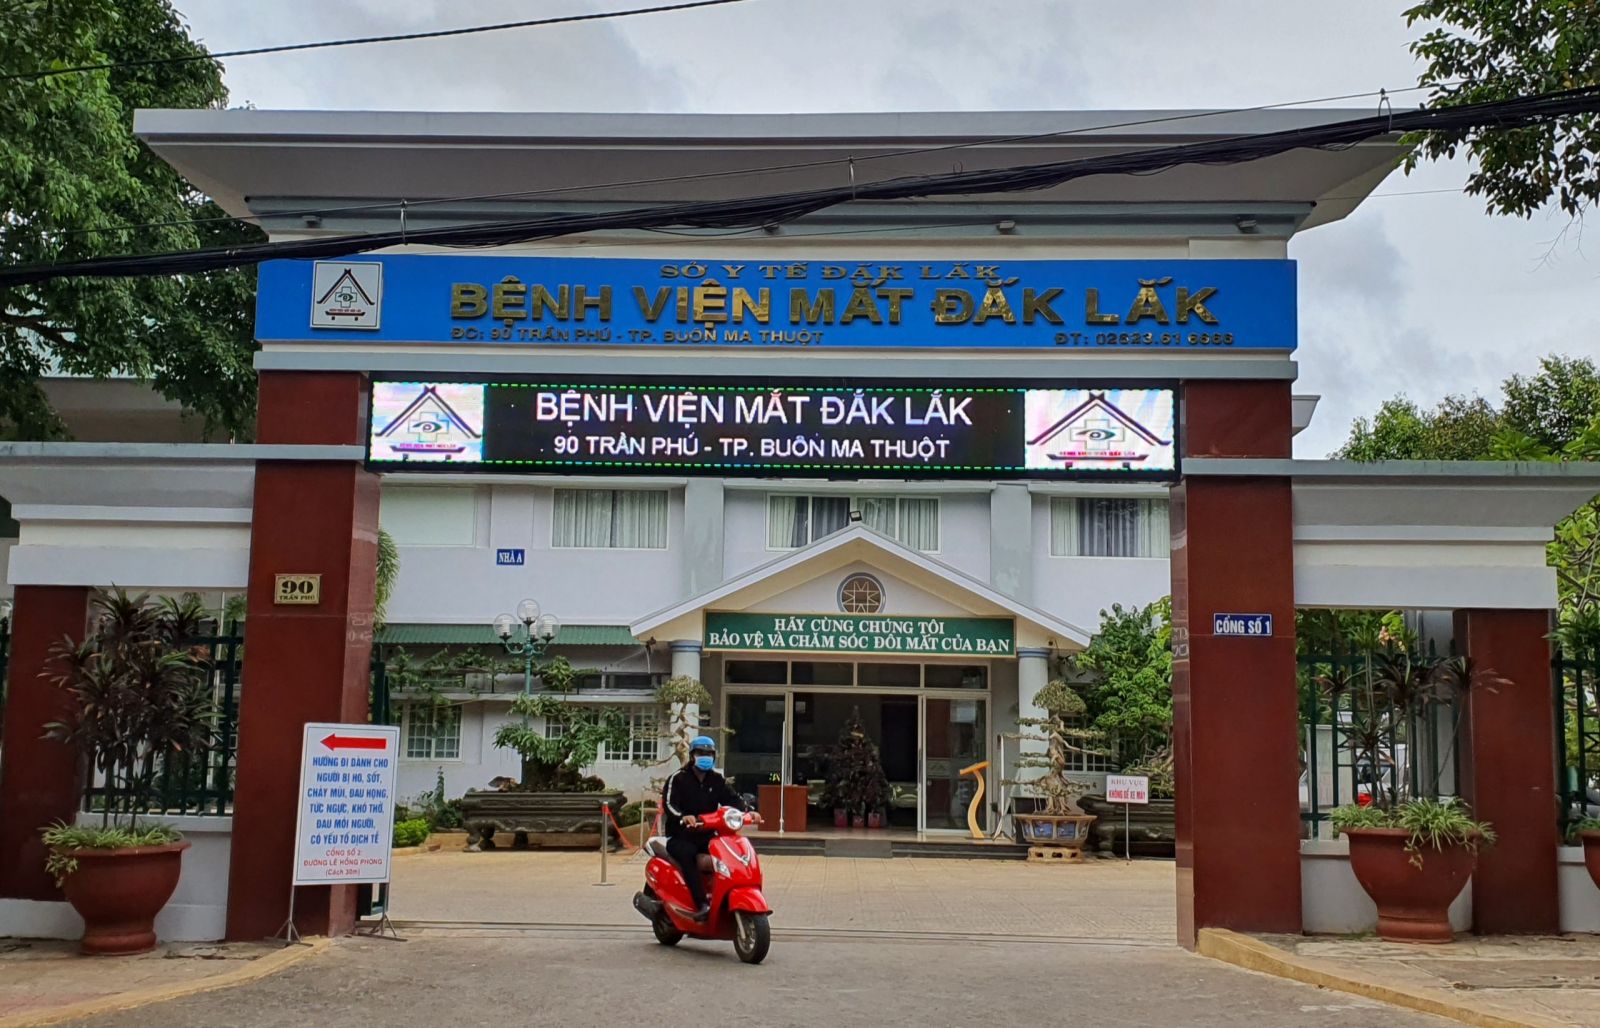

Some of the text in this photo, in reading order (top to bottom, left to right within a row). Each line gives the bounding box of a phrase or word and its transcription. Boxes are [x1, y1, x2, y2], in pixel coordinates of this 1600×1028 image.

[660, 262, 1000, 279] SỞ Y TẾ ĐẮK LẮK
[452, 275, 1219, 329] BỆNH VIỆN MẮT ĐẮK LẮK
[491, 328, 512, 340] 90
[575, 327, 612, 342] PHÚ
[628, 329, 657, 342] TP.
[663, 328, 717, 342] BUÔN
[724, 330, 752, 342] MA
[760, 328, 824, 346] THUỘT
[536, 388, 973, 429] BỆNH VIỆN MẮT ĐẮK LẮK
[554, 436, 579, 454] 90
[585, 432, 645, 455] TRẦN
[651, 432, 699, 456] PHÚ
[719, 438, 754, 457] TP.
[761, 435, 824, 457] BUÔN
[831, 439, 864, 458] MA
[870, 436, 950, 462] THUỘT
[516, 552, 522, 563] A
[281, 580, 314, 594] 90
[774, 616, 945, 634] HÃY CÙNG CHÚNG TÔI
[1216, 614, 1270, 634] CỔNG SỐ 1
[710, 628, 1010, 653] BẢO VỆ VÀ CHĂM SÓC ĐÔI MẮT CỦA BẠN
[341, 758, 349, 767] ĐI
[373, 758, 388, 768] CHO
[316, 771, 340, 783] NGƯỜI
[342, 773, 350, 784] BỊ
[366, 771, 382, 784] SỐT,
[349, 788, 364, 798] ĐAU
[366, 788, 388, 800] HỌNG,
[351, 802, 366, 814] KHÓ
[316, 819, 332, 828] ĐAU
[310, 833, 321, 844] CÓ
[323, 831, 338, 844] YẾU
[340, 831, 350, 844] TỐ
[350, 834, 368, 846] DỊCH
